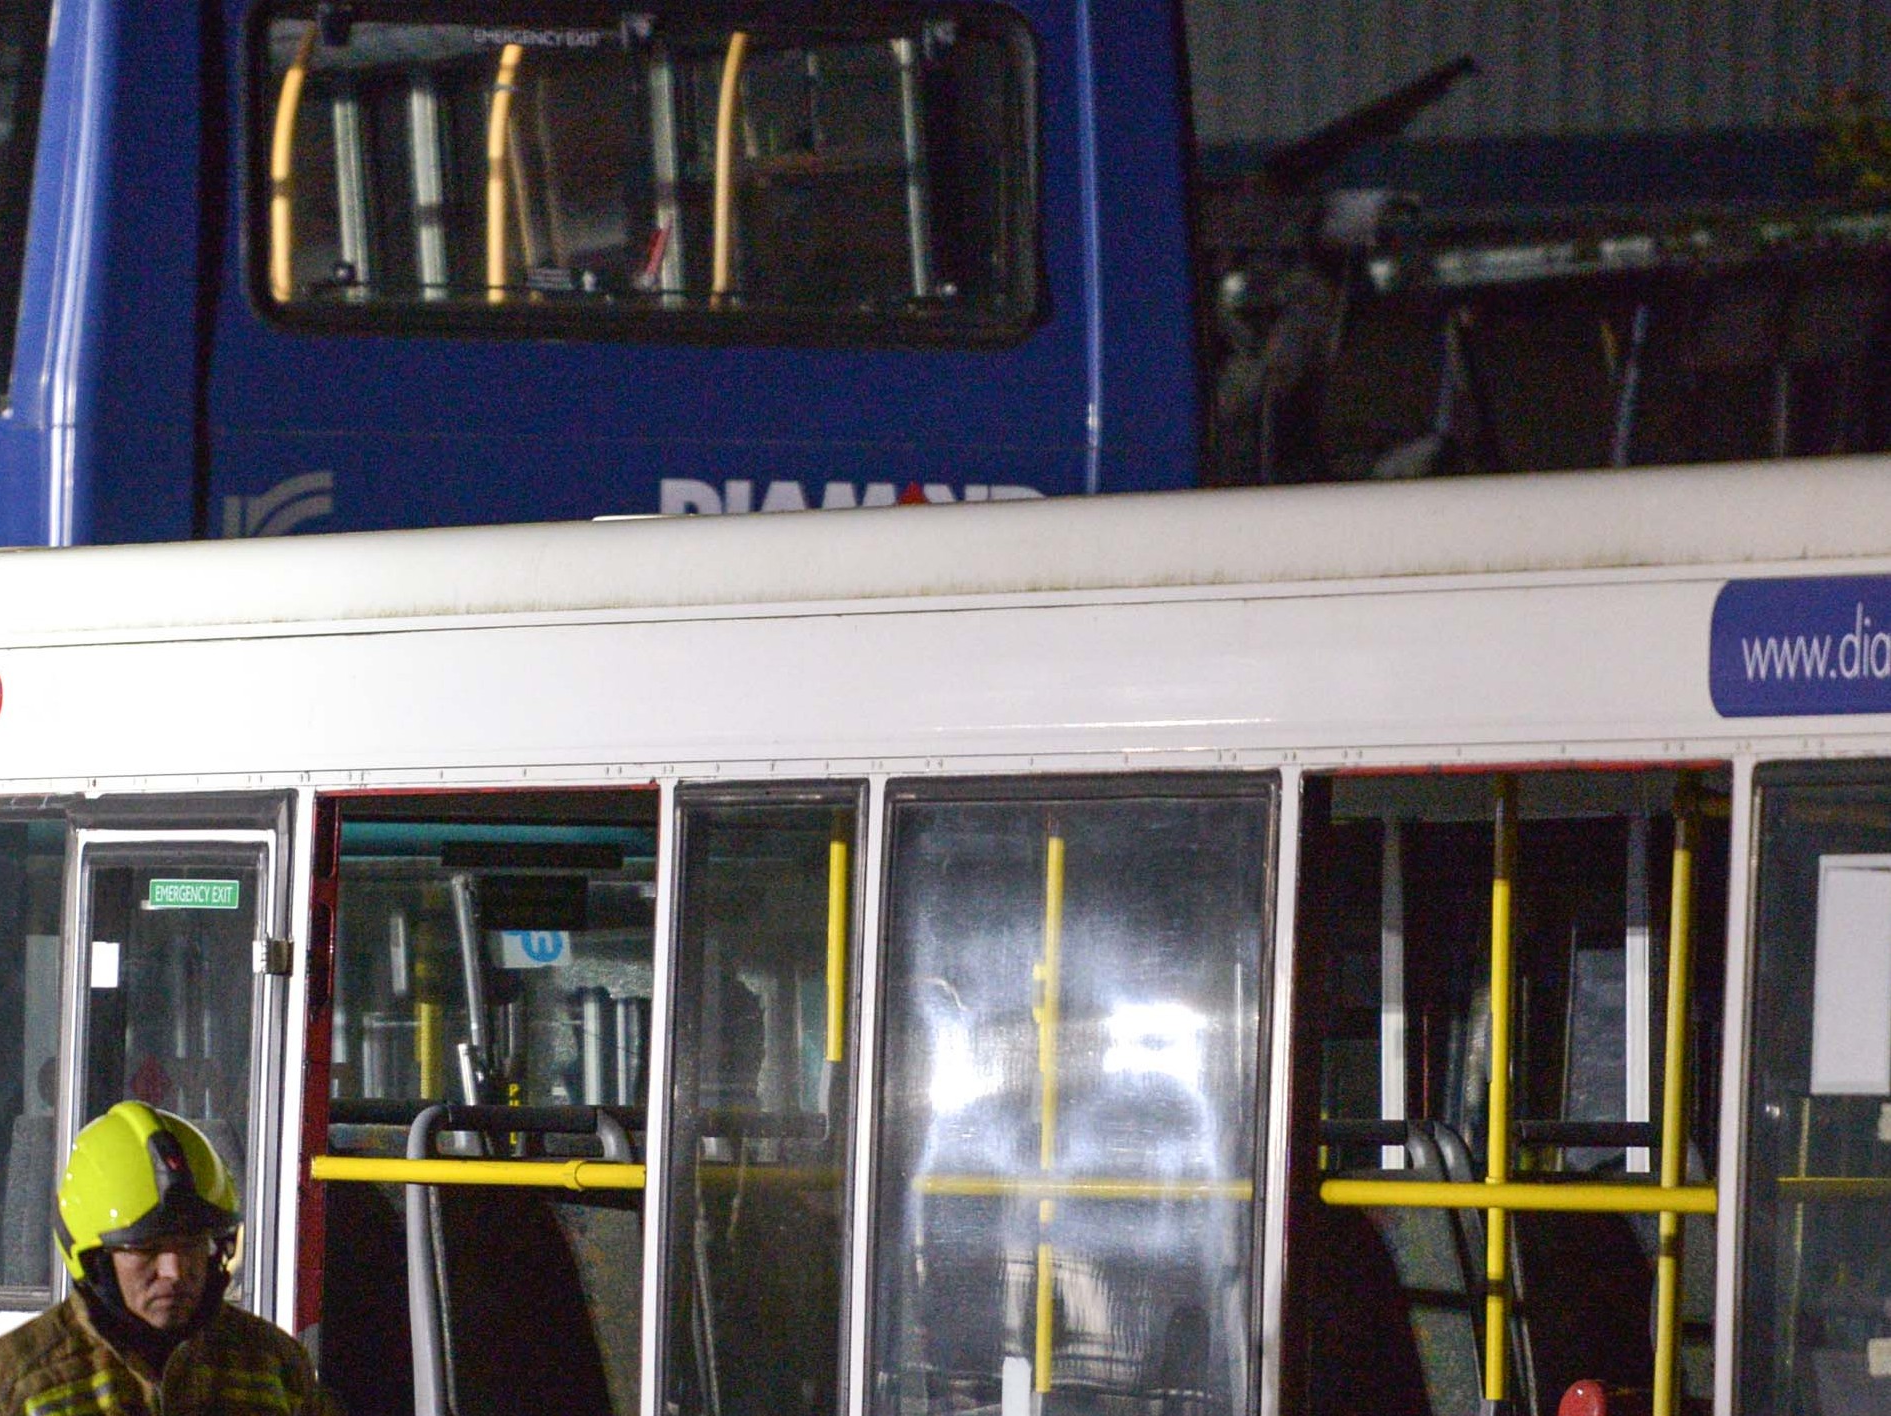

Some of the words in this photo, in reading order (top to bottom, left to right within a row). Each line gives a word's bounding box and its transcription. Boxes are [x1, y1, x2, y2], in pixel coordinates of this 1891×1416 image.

[473, 28, 563, 45] EMERGENCY
[566, 30, 600, 46] EXIT
[1742, 601, 1891, 681] www.dia
[155, 886, 210, 903] EMERGENCY
[212, 886, 233, 903] EXIT
